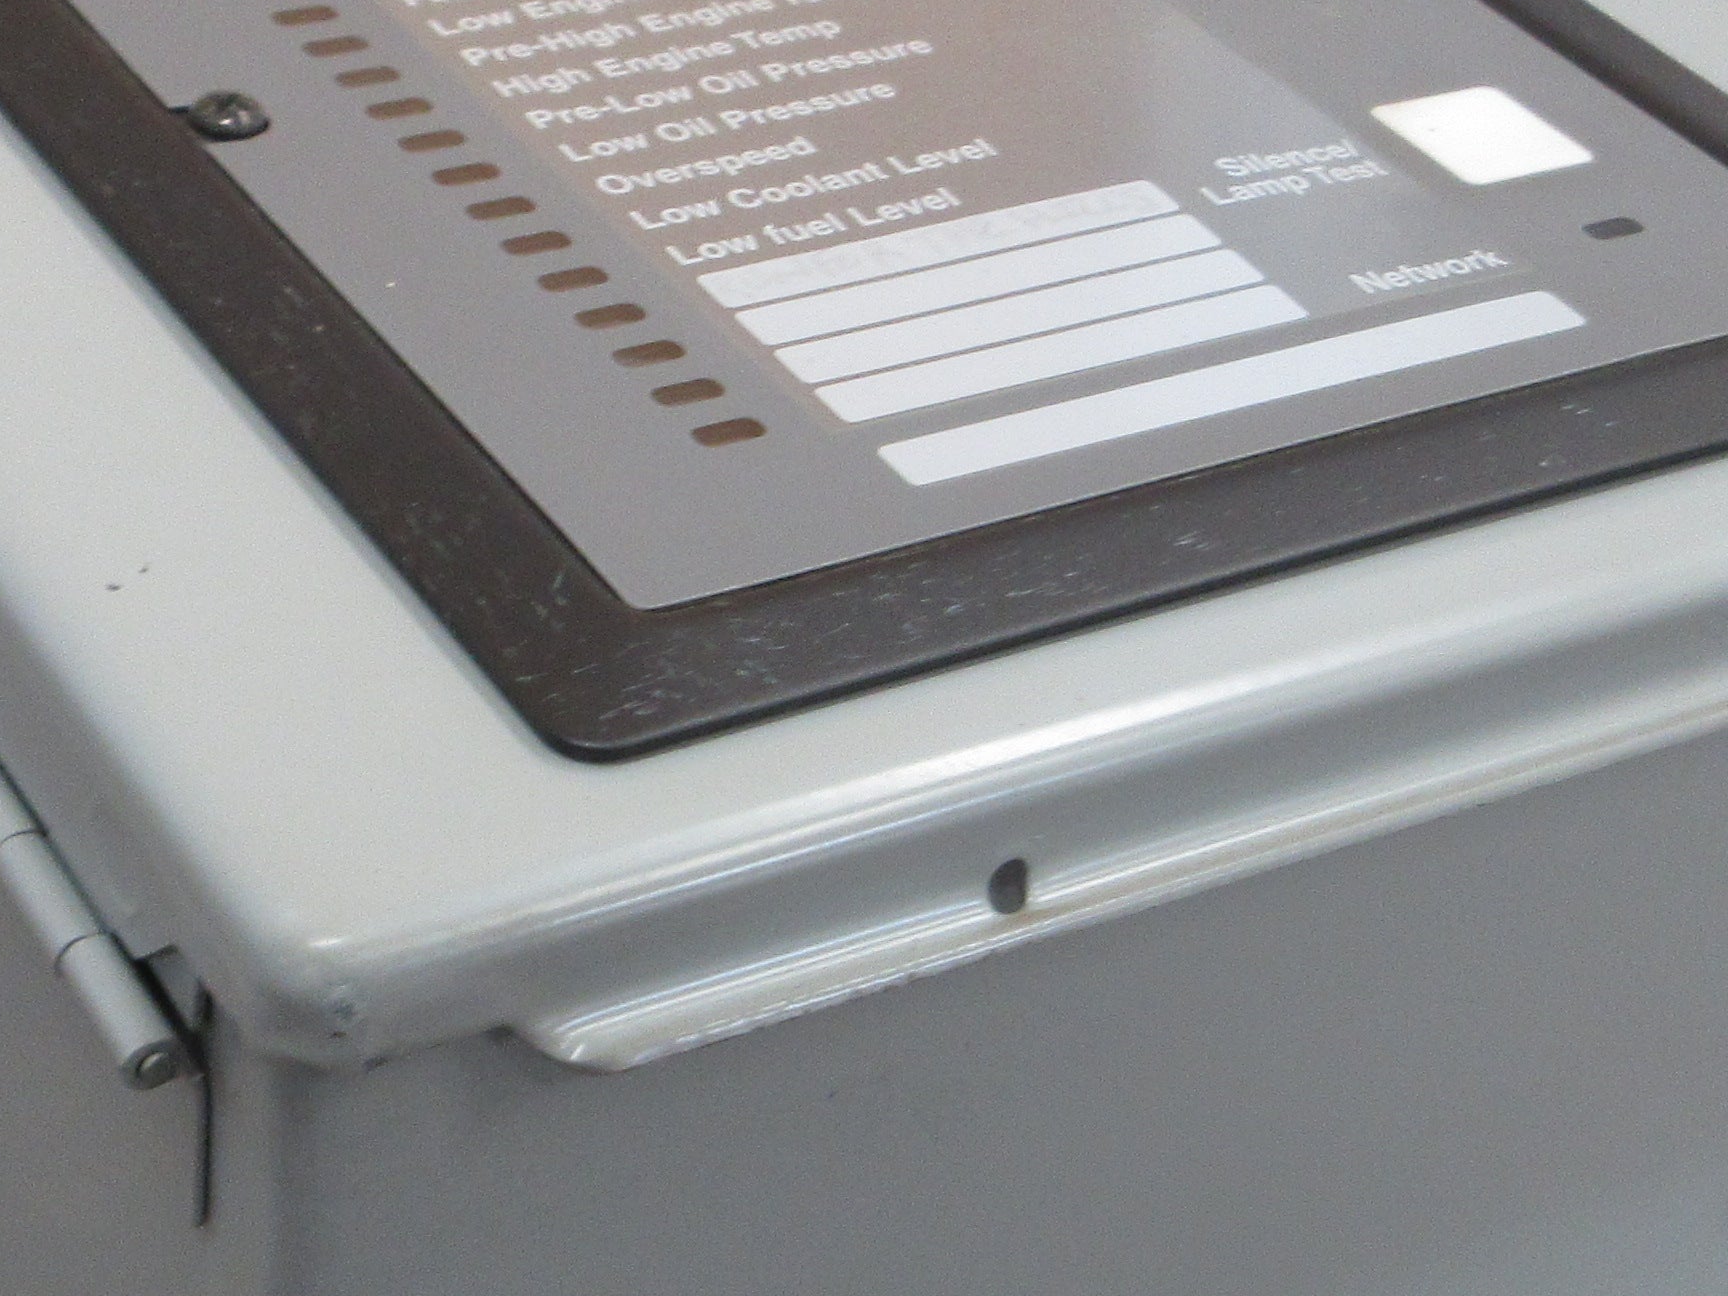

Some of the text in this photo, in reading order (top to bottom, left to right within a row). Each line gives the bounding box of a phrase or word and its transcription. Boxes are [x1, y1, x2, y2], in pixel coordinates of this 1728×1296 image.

[429, 11, 513, 37] Low
[460, 19, 635, 66] Pre-High
[492, 19, 842, 98] High Engine Temp
[525, 37, 934, 130] Pre-Low Oil Pressure
[559, 81, 897, 163] Low Oil Pressure
[595, 137, 818, 196] Overspeed
[629, 138, 1000, 230] Low Coolant Level
[1200, 161, 1388, 205] Lamp Test
[1214, 139, 1359, 178] Silence/
[665, 187, 961, 266] Low fuel Level
[1350, 248, 1508, 293] Network
